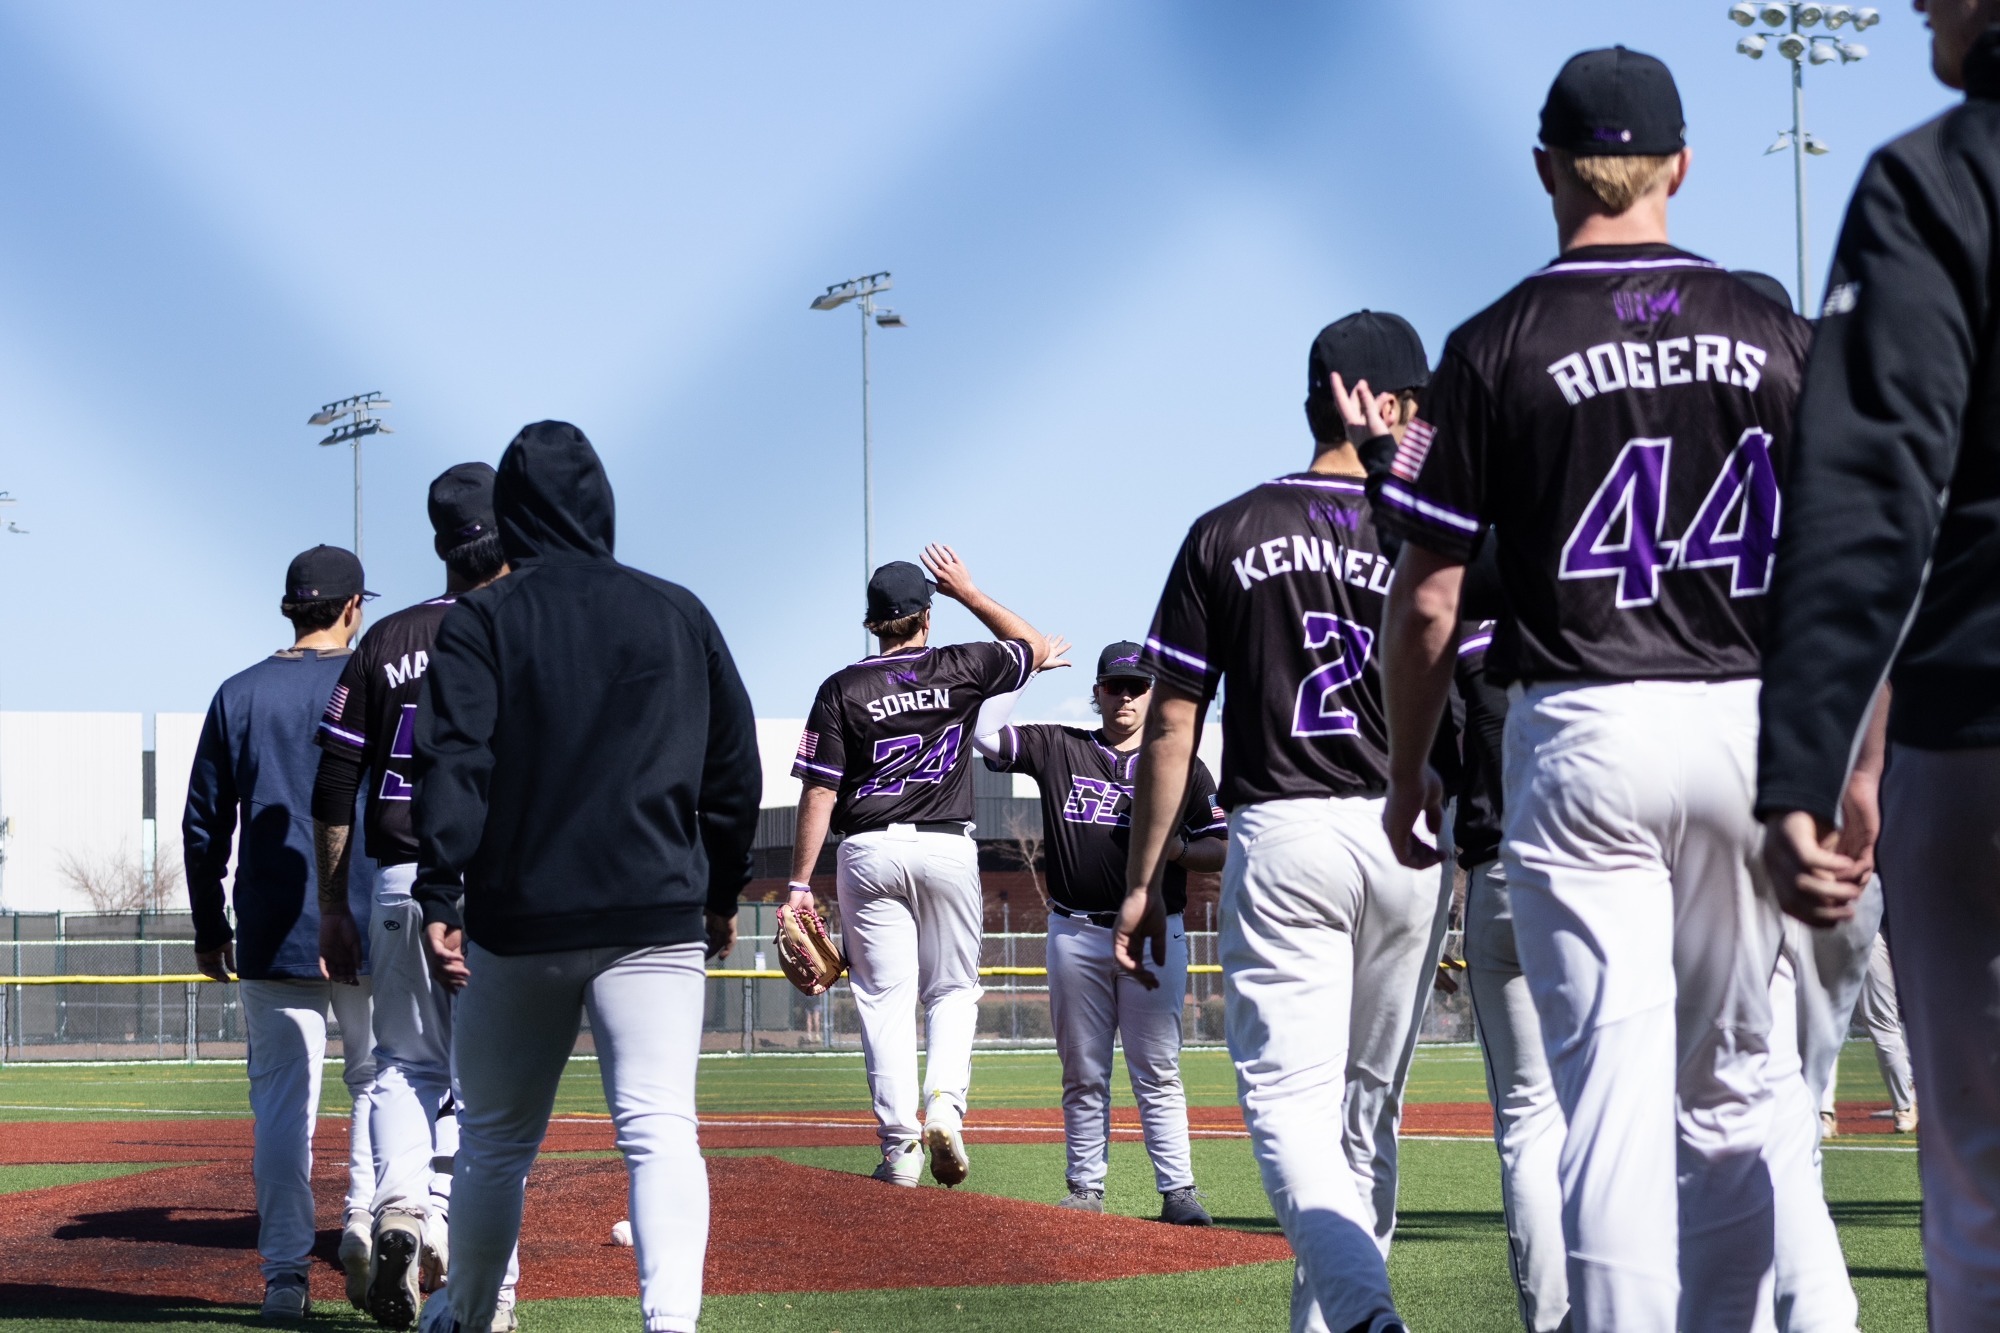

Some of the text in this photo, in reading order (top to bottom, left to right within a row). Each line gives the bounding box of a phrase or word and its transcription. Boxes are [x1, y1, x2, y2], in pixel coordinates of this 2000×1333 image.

[1546, 334, 1768, 406] ROGERS
[1558, 426, 1782, 609] 44
[1232, 534, 1396, 596] KENNED
[384, 651, 430, 689] MA
[1291, 611, 1375, 739] 2
[866, 688, 950, 723] SOREN
[855, 723, 964, 799] 24
[1063, 774, 1135, 827] GC
